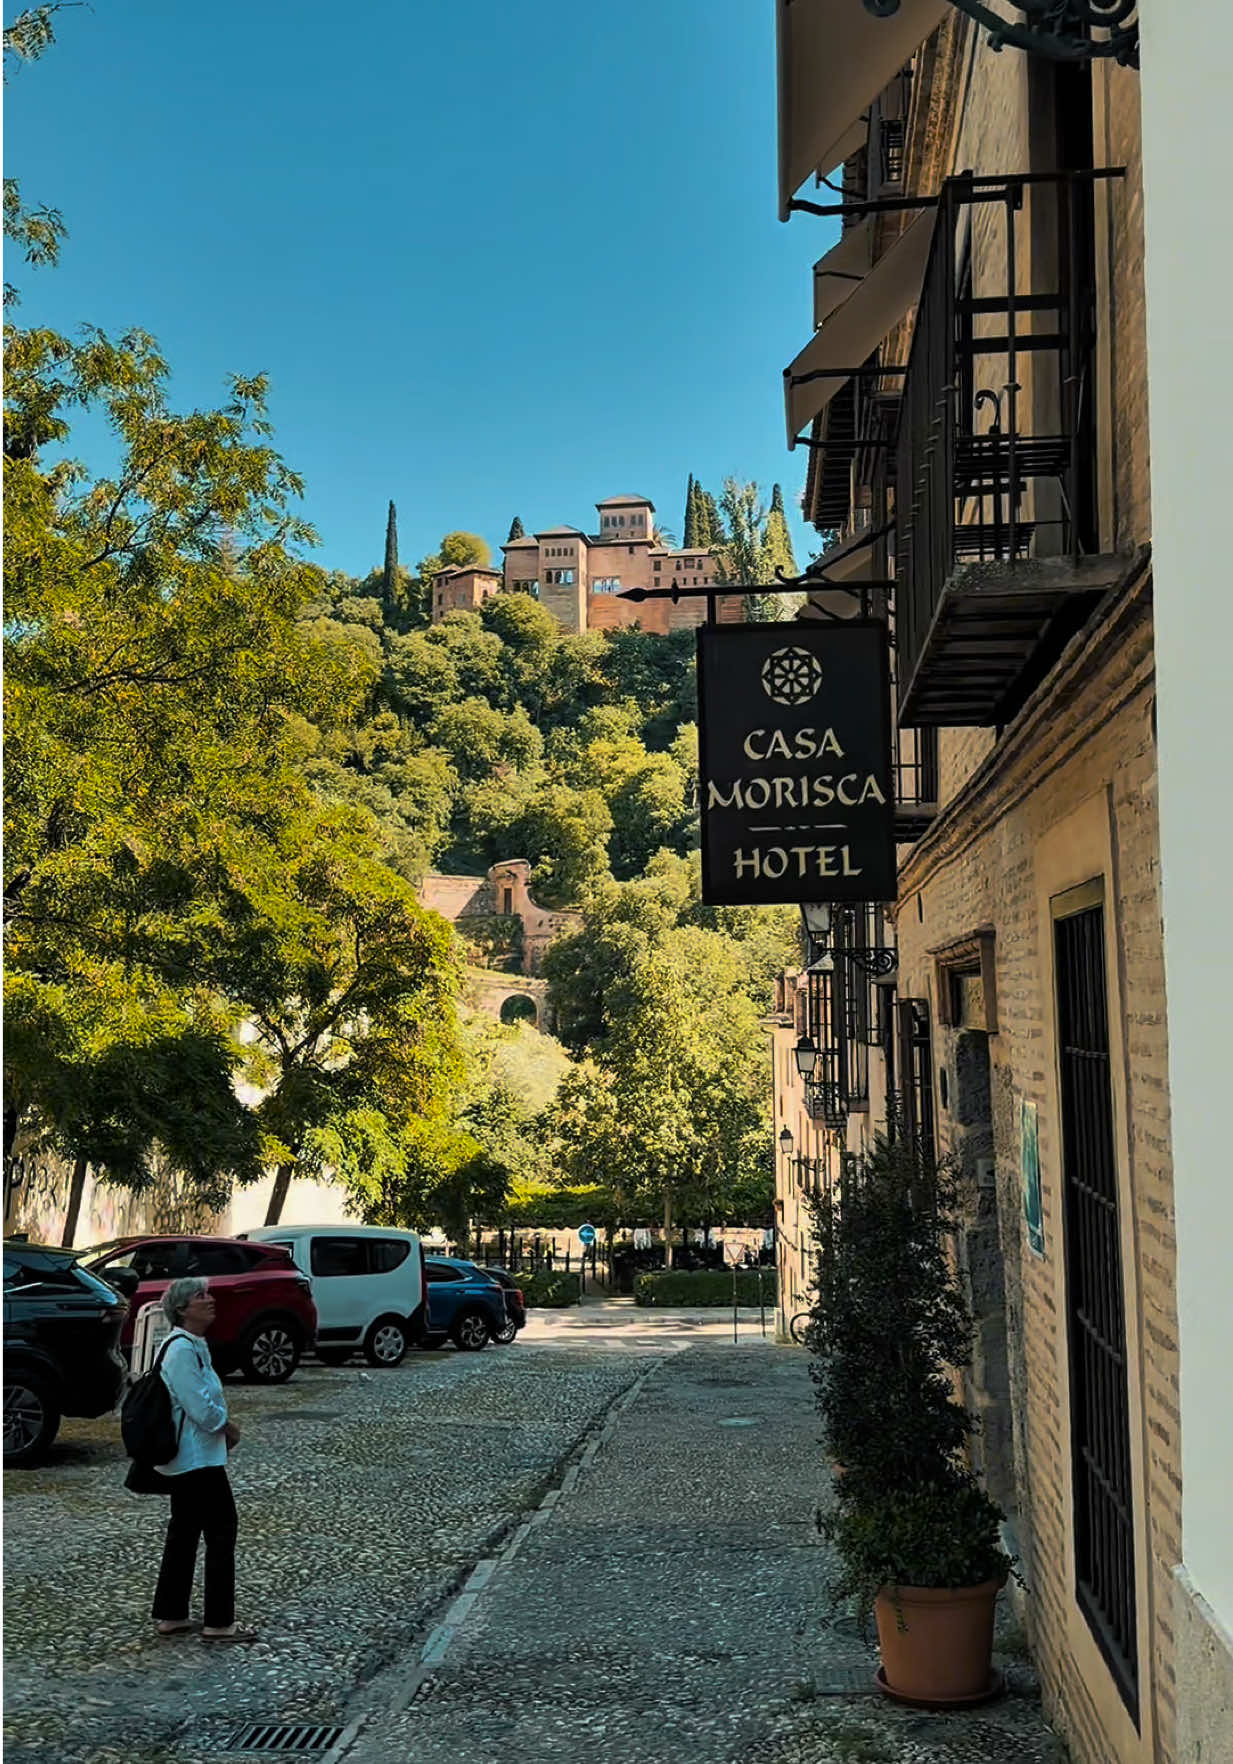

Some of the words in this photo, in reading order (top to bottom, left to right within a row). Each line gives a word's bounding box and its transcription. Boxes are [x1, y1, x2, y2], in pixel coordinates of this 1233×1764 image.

[743, 728, 844, 760] CASA
[708, 774, 886, 809] MORISCA
[733, 845, 862, 879] HOTEL
